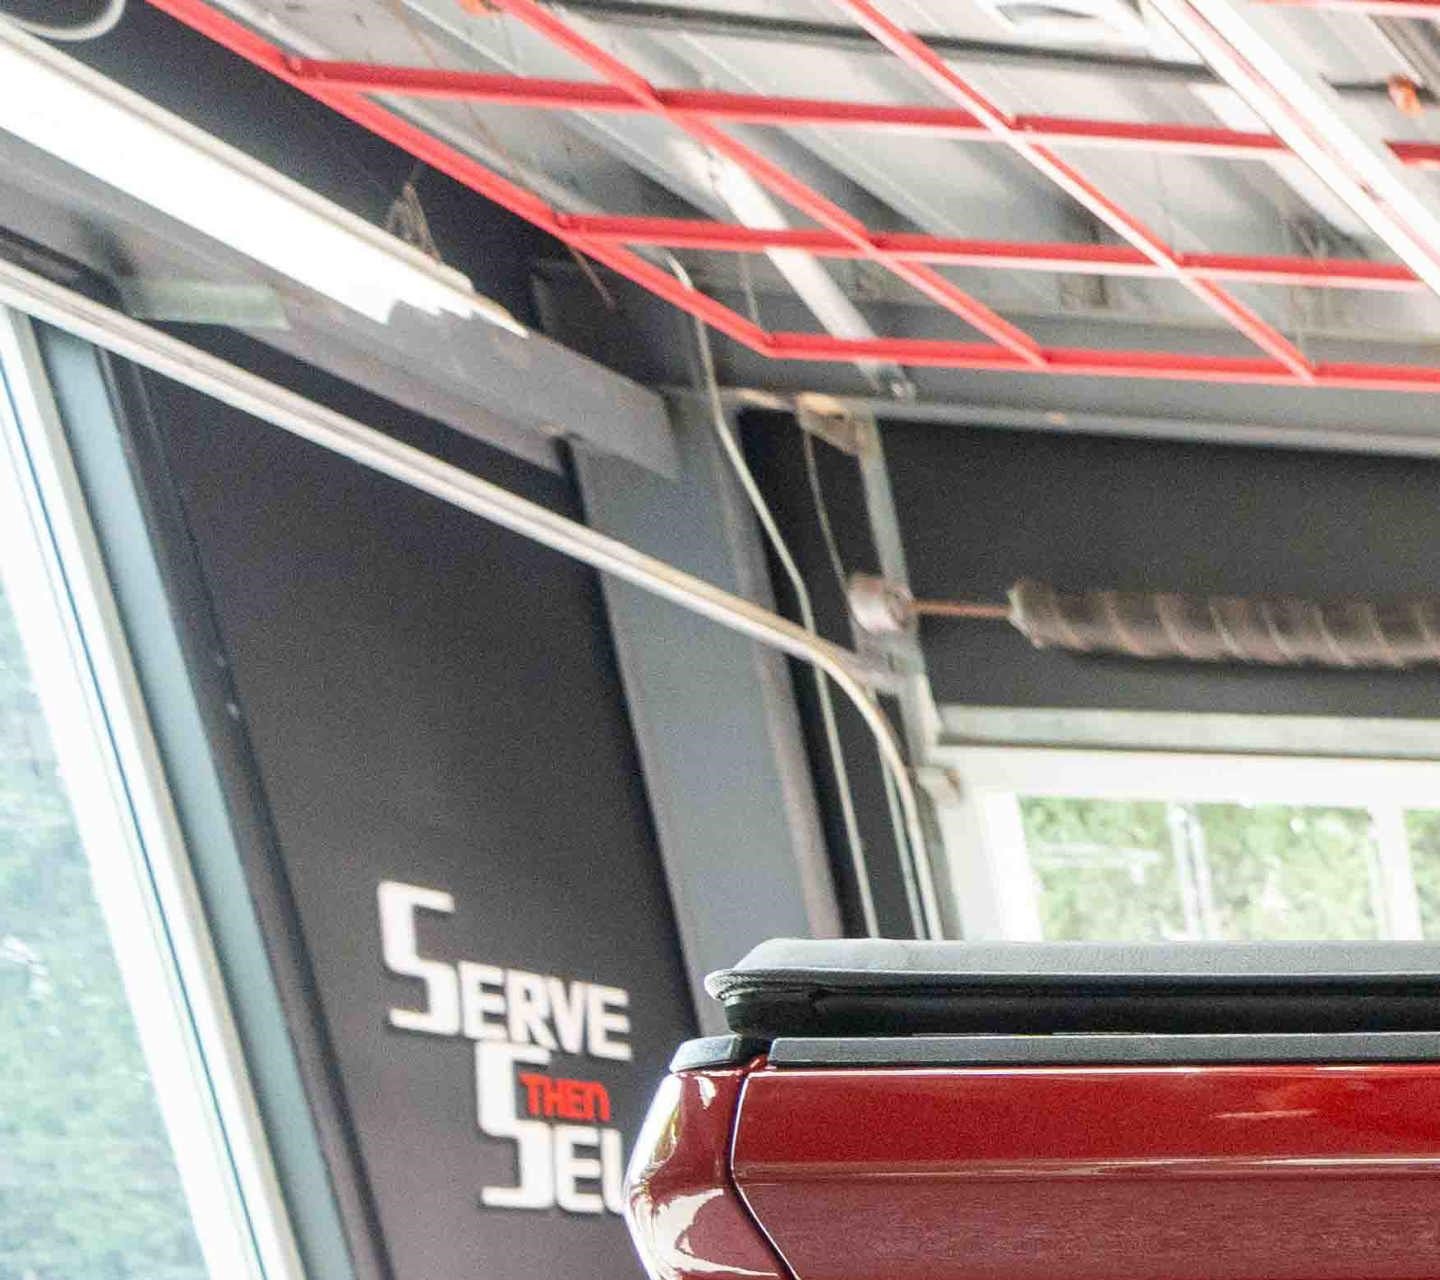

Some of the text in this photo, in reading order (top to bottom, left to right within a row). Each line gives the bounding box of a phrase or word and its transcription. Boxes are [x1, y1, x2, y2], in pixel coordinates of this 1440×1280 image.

[377, 880, 633, 1060] SERVE
[475, 1040, 626, 1215] SEL
[518, 1072, 612, 1122] THEN
